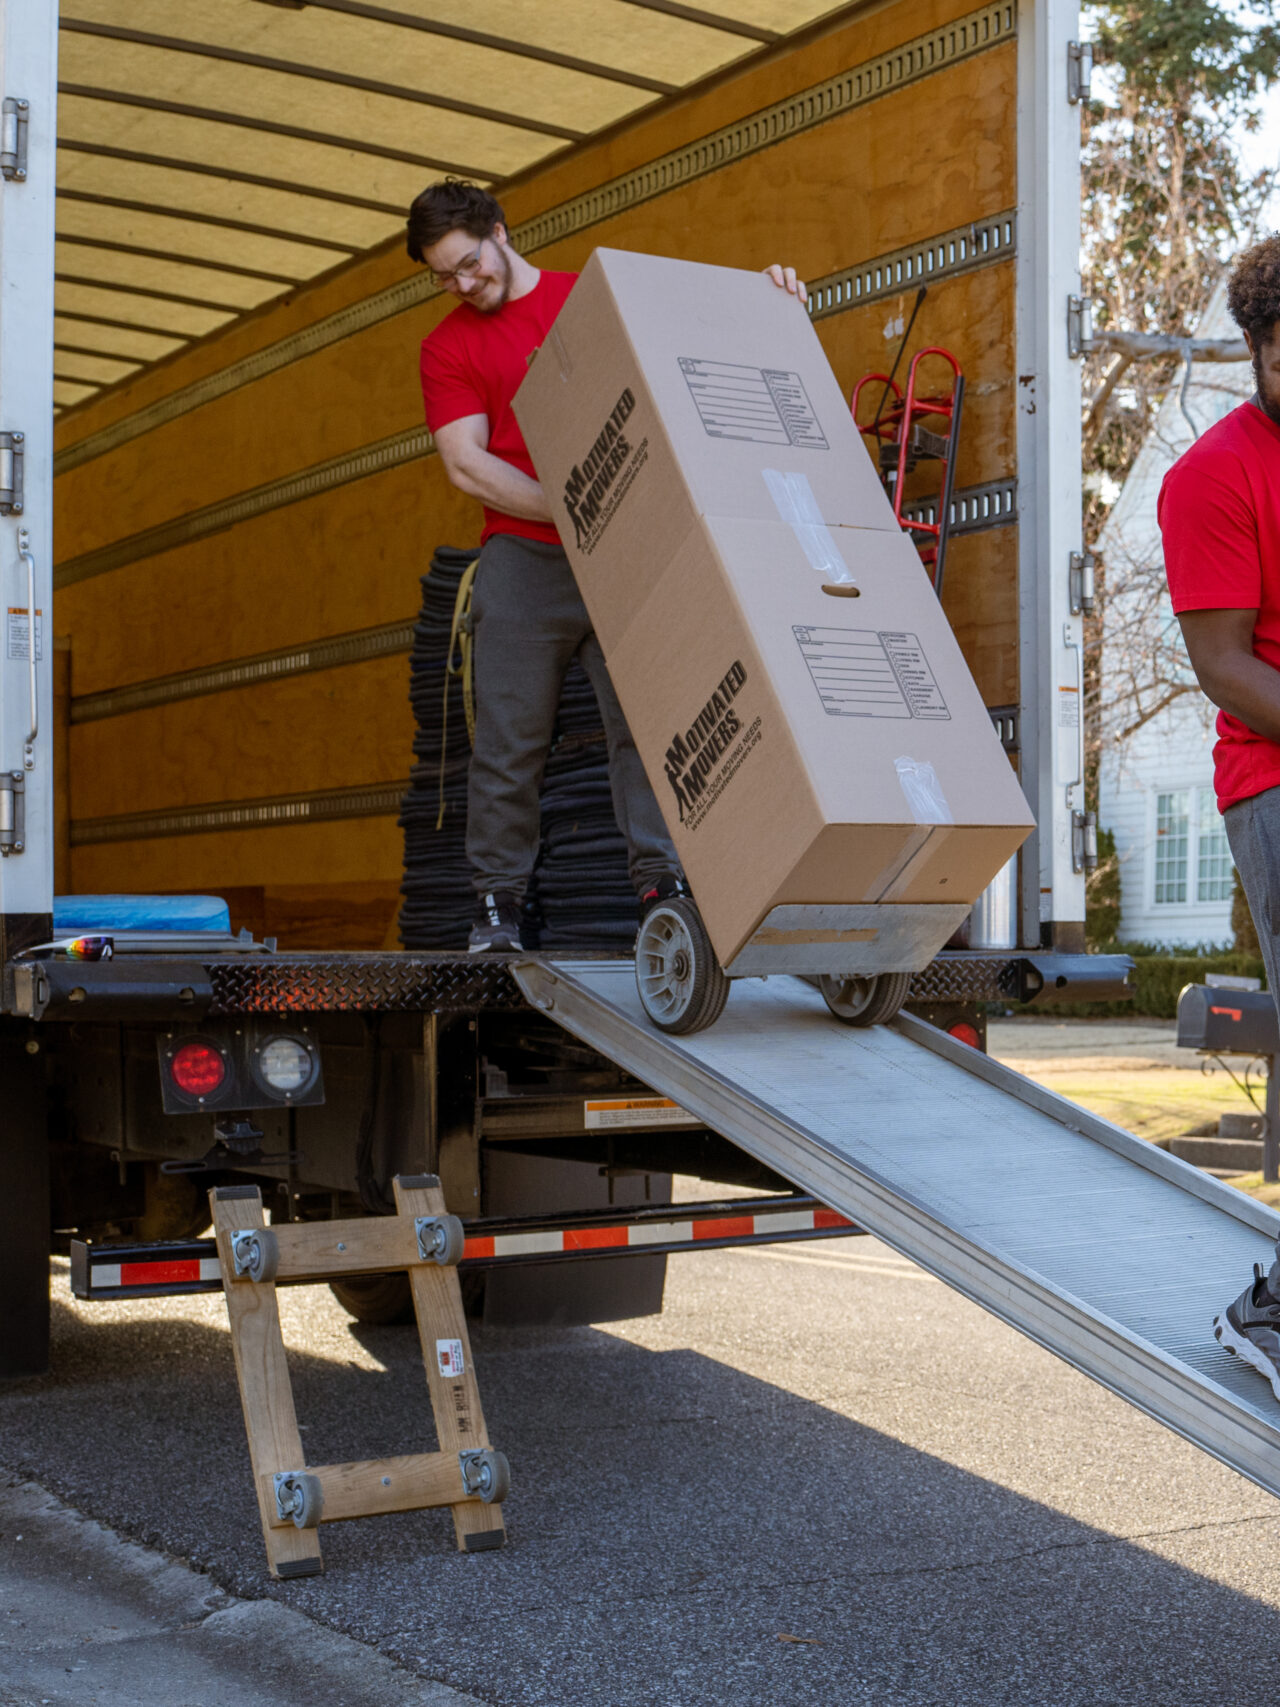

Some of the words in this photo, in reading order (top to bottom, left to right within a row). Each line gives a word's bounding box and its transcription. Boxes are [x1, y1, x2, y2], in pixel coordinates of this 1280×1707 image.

[565, 386, 636, 504] MOTIVATED
[665, 659, 748, 777] MOTIVATED
[682, 708, 742, 802] MOVERS
[684, 811, 697, 830] FOR
[696, 796, 707, 814] ALL
[706, 774, 722, 798] YOUR
[722, 744, 744, 776] MOVING
[742, 716, 762, 747] NEEDS
